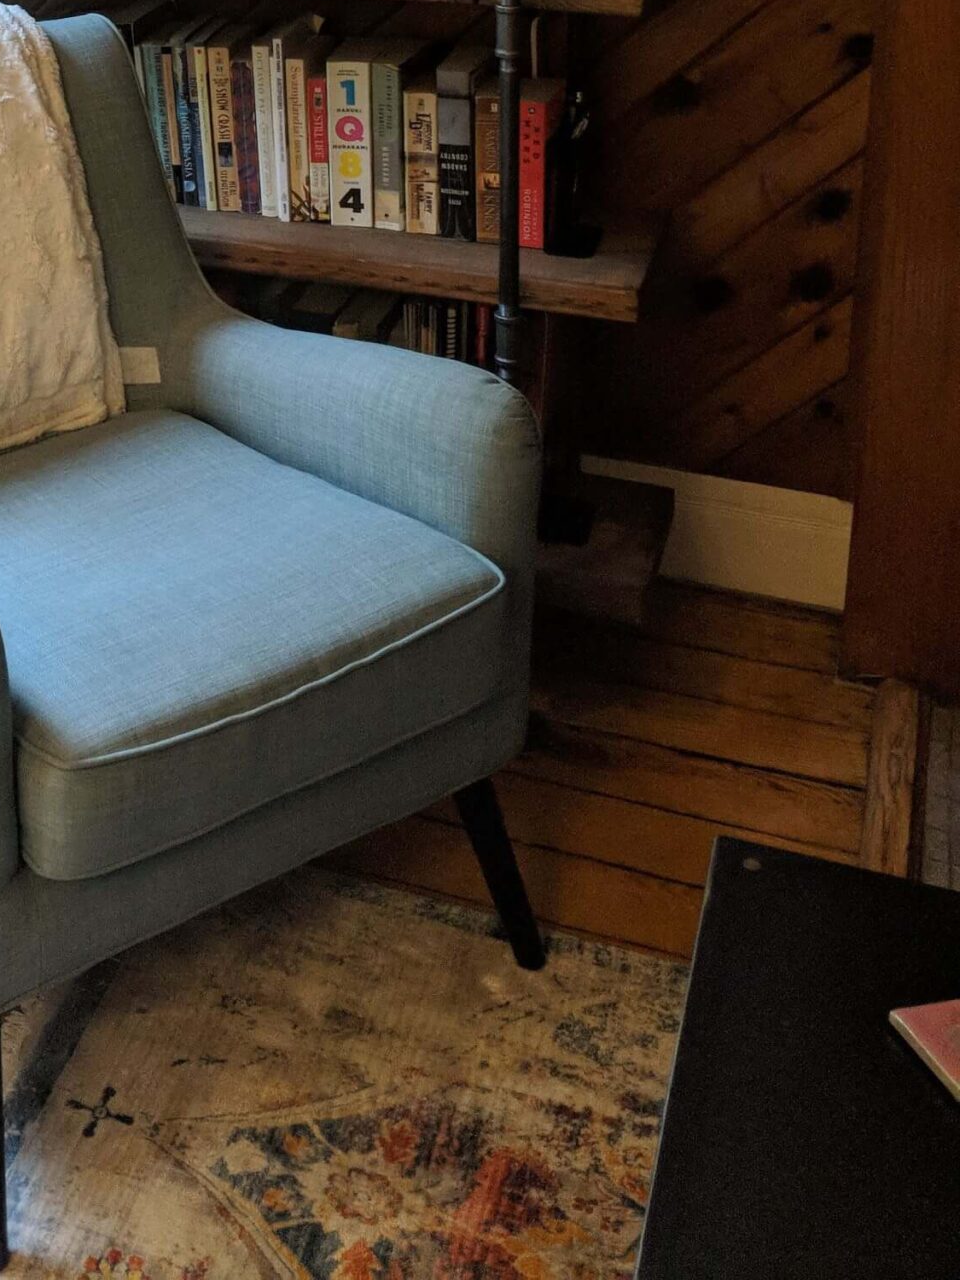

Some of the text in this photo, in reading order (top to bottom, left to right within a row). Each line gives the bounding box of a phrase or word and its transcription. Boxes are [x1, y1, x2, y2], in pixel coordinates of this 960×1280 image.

[255, 51, 266, 114] OCTAVIO PAZ
[339, 80, 356, 106] 1
[215, 86, 230, 140] SNOW CRASH
[290, 66, 305, 138] Swamplandia!
[181, 112, 191, 141] HOME
[313, 112, 325, 158] STILL LIFE
[335, 115, 364, 142] Q
[183, 142, 192, 153] IN
[522, 120, 530, 164] MARS
[184, 152, 196, 178] ASIA
[339, 151, 362, 179] 8
[440, 153, 469, 161] COUNTRY
[338, 188, 365, 214] 4
[484, 194, 496, 233] KINGS
[523, 188, 532, 241] ROBINSON
